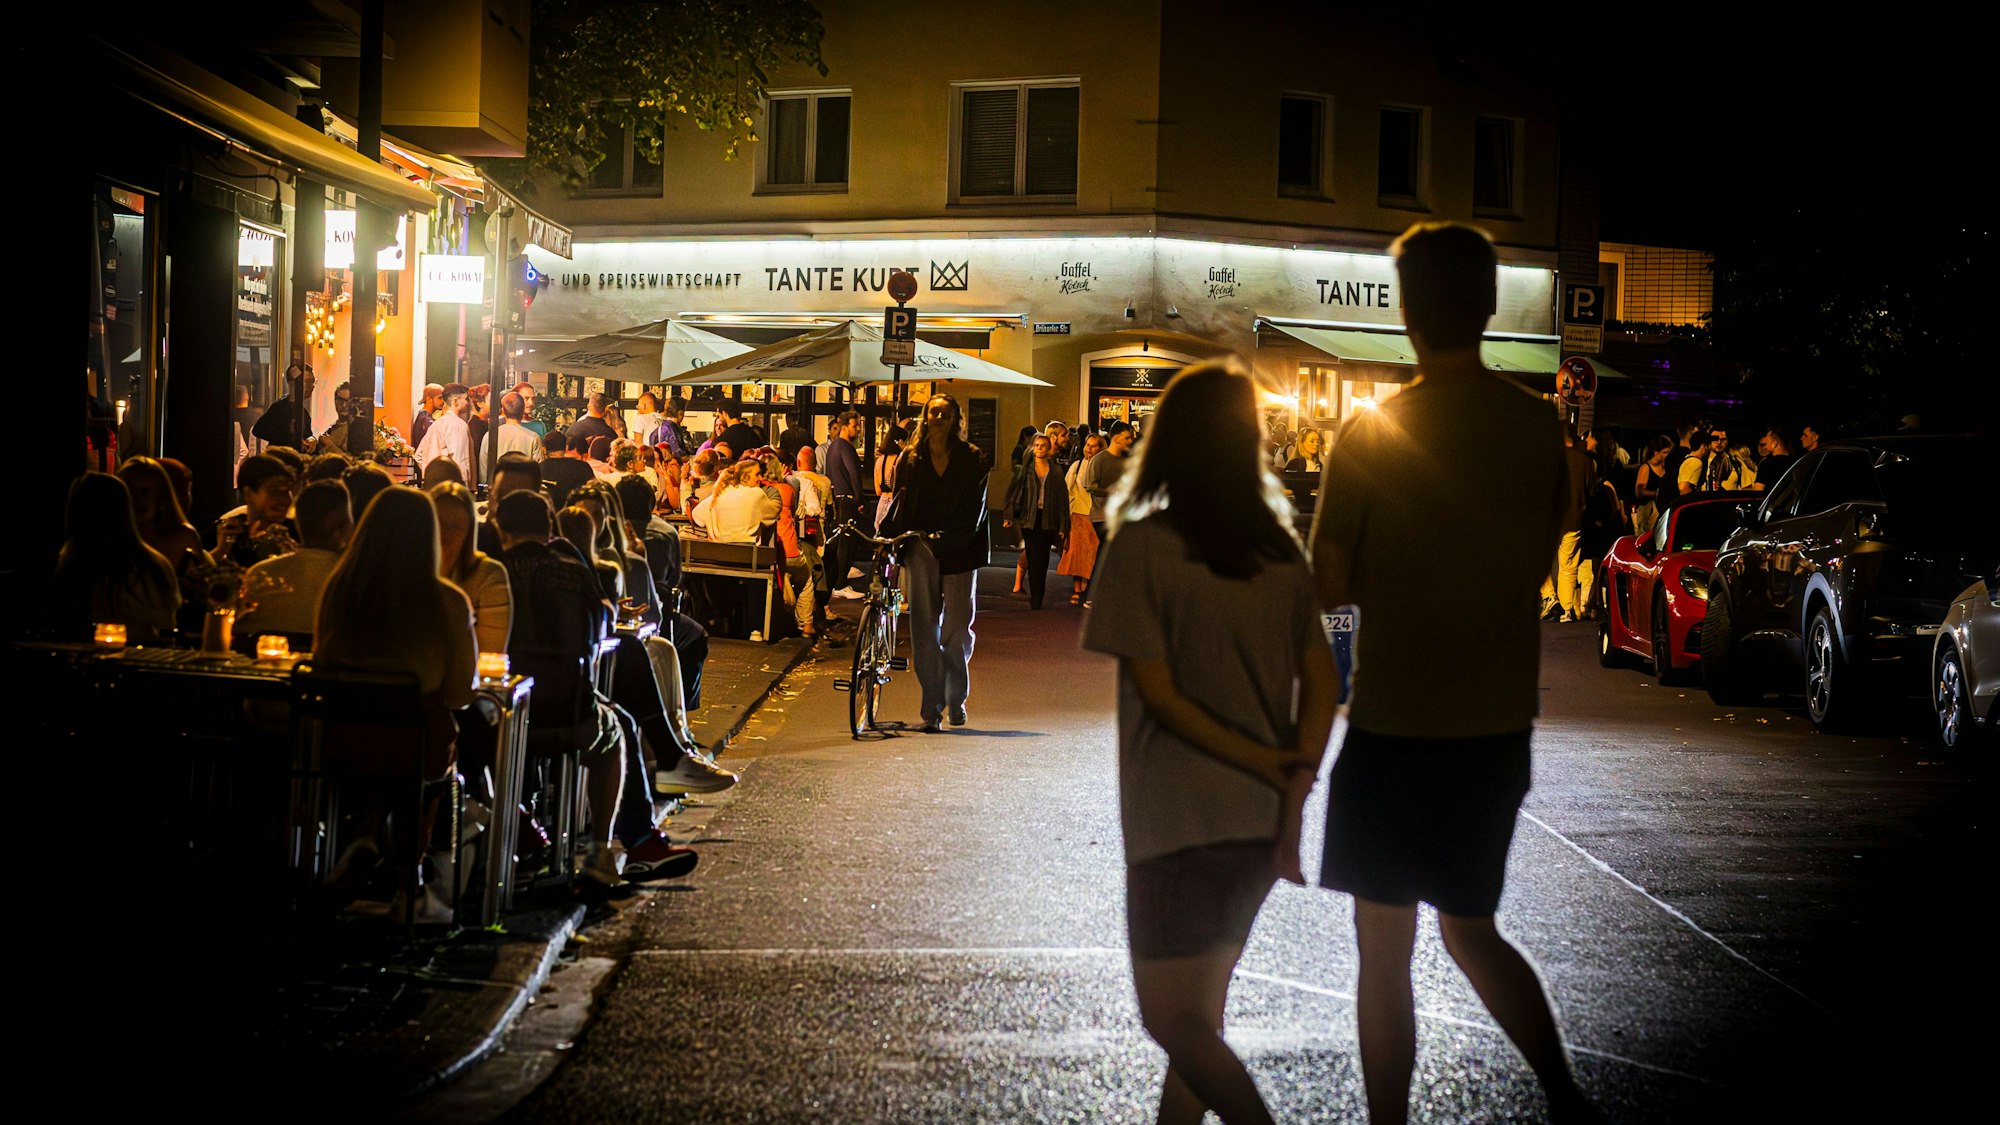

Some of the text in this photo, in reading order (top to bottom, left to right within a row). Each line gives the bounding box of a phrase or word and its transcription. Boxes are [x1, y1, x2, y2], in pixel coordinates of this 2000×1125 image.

[562, 273, 742, 287] UND SPEISEWIRTSCHAFT
[765, 267, 920, 292] TANTE KUT
[1061, 261, 1091, 278] Gaffel
[1209, 266, 1236, 283] Gaffel
[1316, 279, 1389, 308] TANTE
[1573, 287, 1595, 318] P
[892, 311, 909, 336] P
